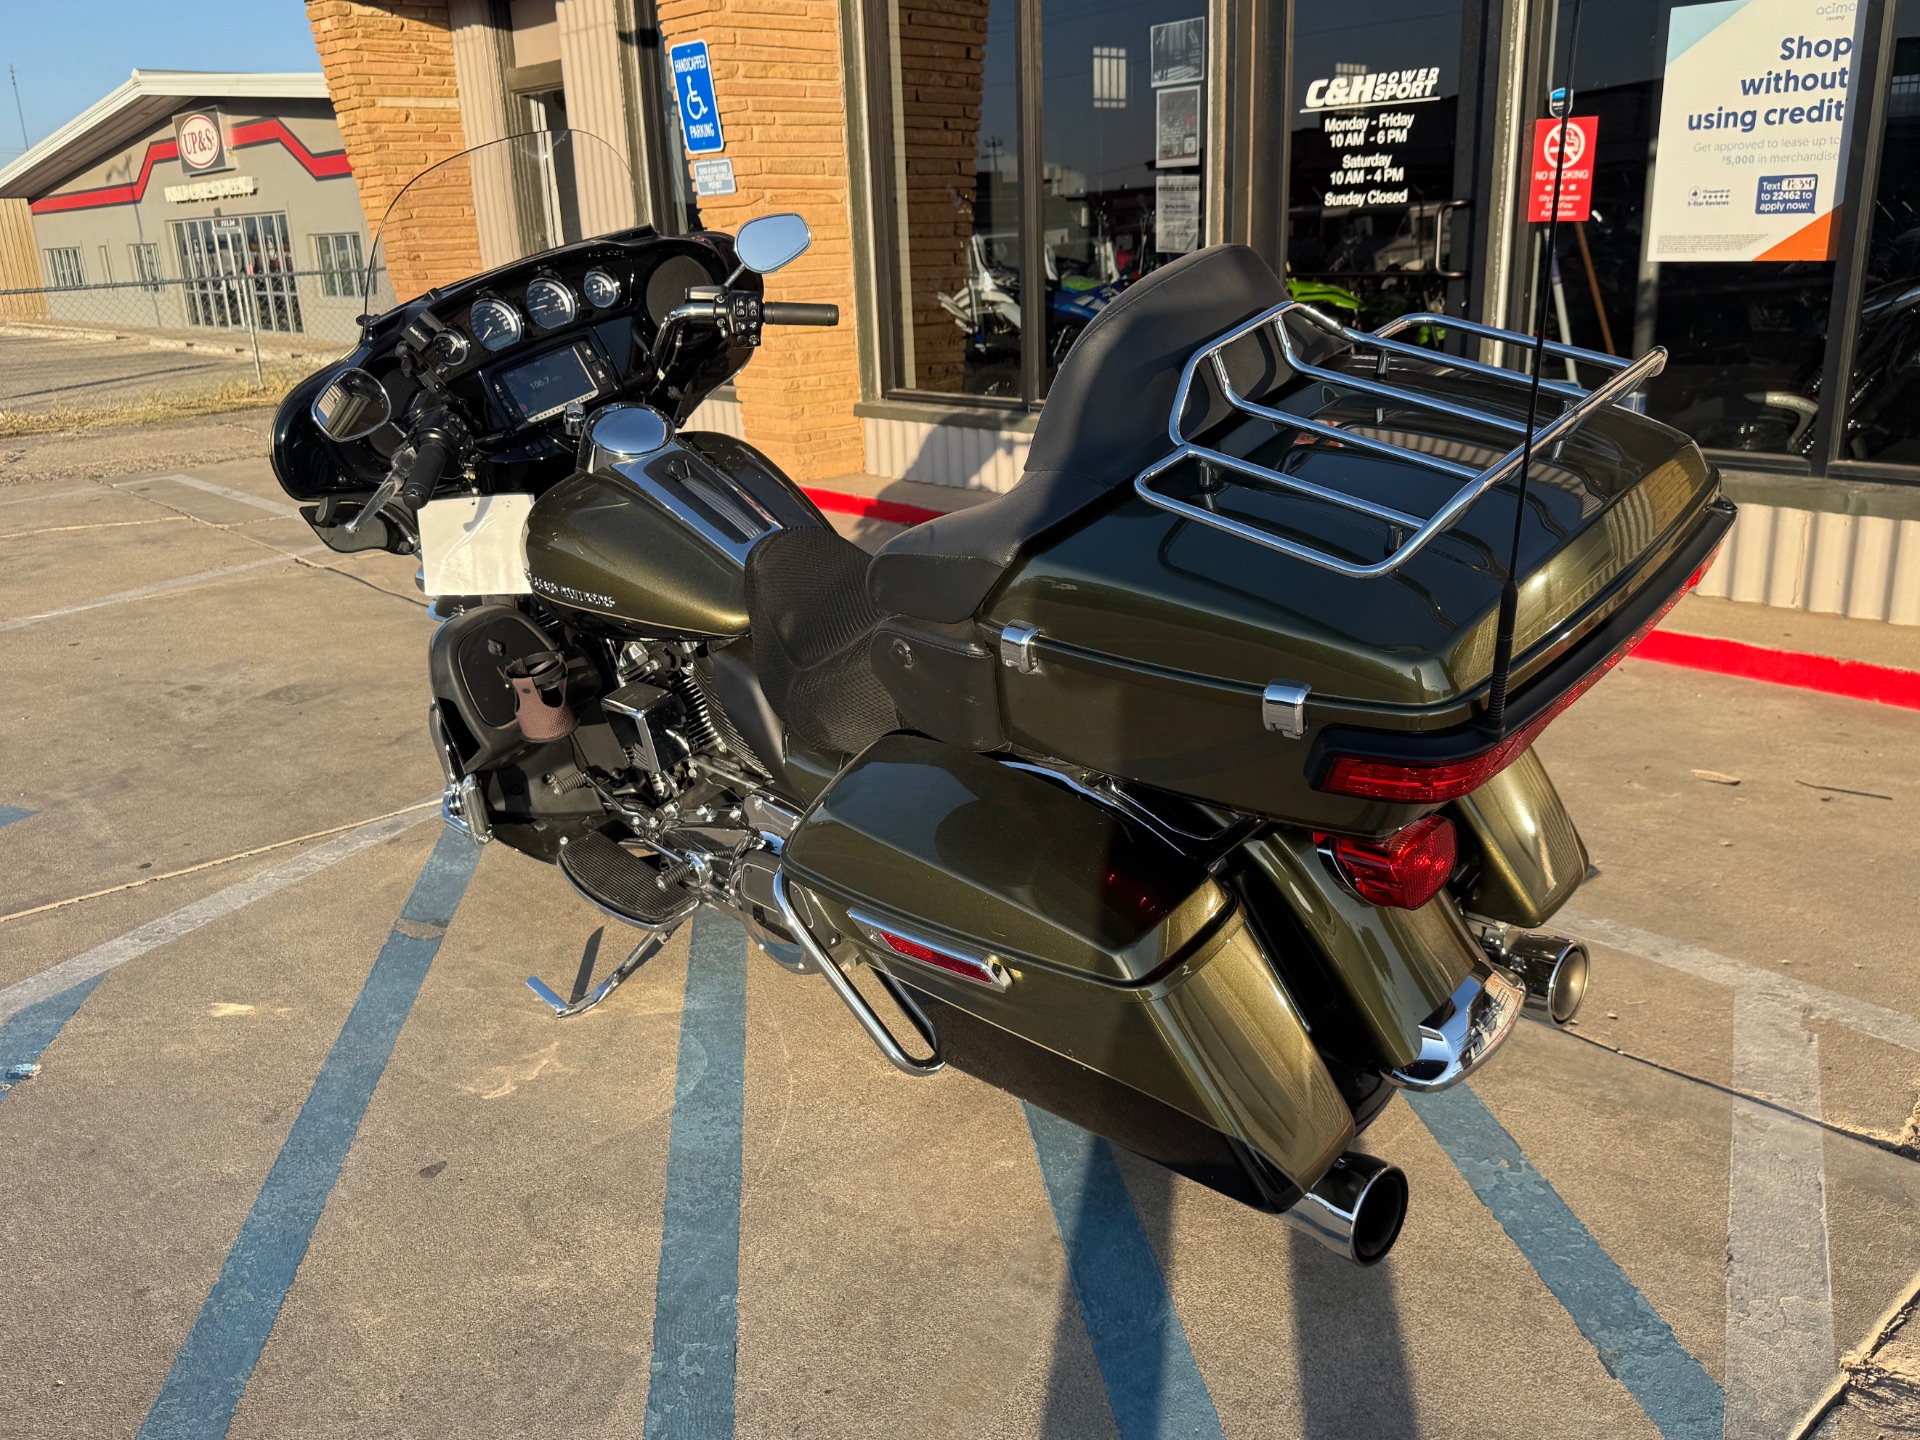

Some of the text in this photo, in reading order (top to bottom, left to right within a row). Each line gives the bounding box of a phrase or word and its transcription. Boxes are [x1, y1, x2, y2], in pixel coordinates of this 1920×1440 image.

[1780, 36, 1853, 62] Shop
[674, 54, 707, 73] HANDICAPPED
[1306, 67, 1440, 107] C&H POWER
[1373, 80, 1437, 101] SPORT
[1741, 67, 1848, 96] without
[1325, 116, 1370, 132] Monday
[1379, 112, 1415, 129] Friday
[1688, 106, 1757, 133] using
[689, 122, 715, 139] PARKING
[1330, 133, 1344, 148] 10
[1344, 132, 1365, 147] AM
[1376, 130, 1386, 145] 6
[1387, 129, 1408, 143] PM
[1693, 143, 1711, 153] Get
[1714, 139, 1764, 154] approved
[1767, 140, 1778, 149] to
[1781, 138, 1809, 148] lease
[1812, 138, 1827, 148] up
[1342, 152, 1393, 169] Saturday
[1722, 151, 1839, 166] $5,000 in merchandise
[1330, 170, 1344, 185] 10
[1344, 169, 1365, 185] AM
[1373, 168, 1382, 183] 4
[1383, 167, 1404, 182] PM
[1535, 169, 1589, 181] NO SOKING
[1762, 182, 1781, 190] Text
[1324, 188, 1409, 207] Sunday Closed
[1761, 193, 1771, 201] to
[1772, 191, 1801, 200] 22462
[1760, 202, 1785, 212] apply
[529, 376, 551, 391] 106.7
